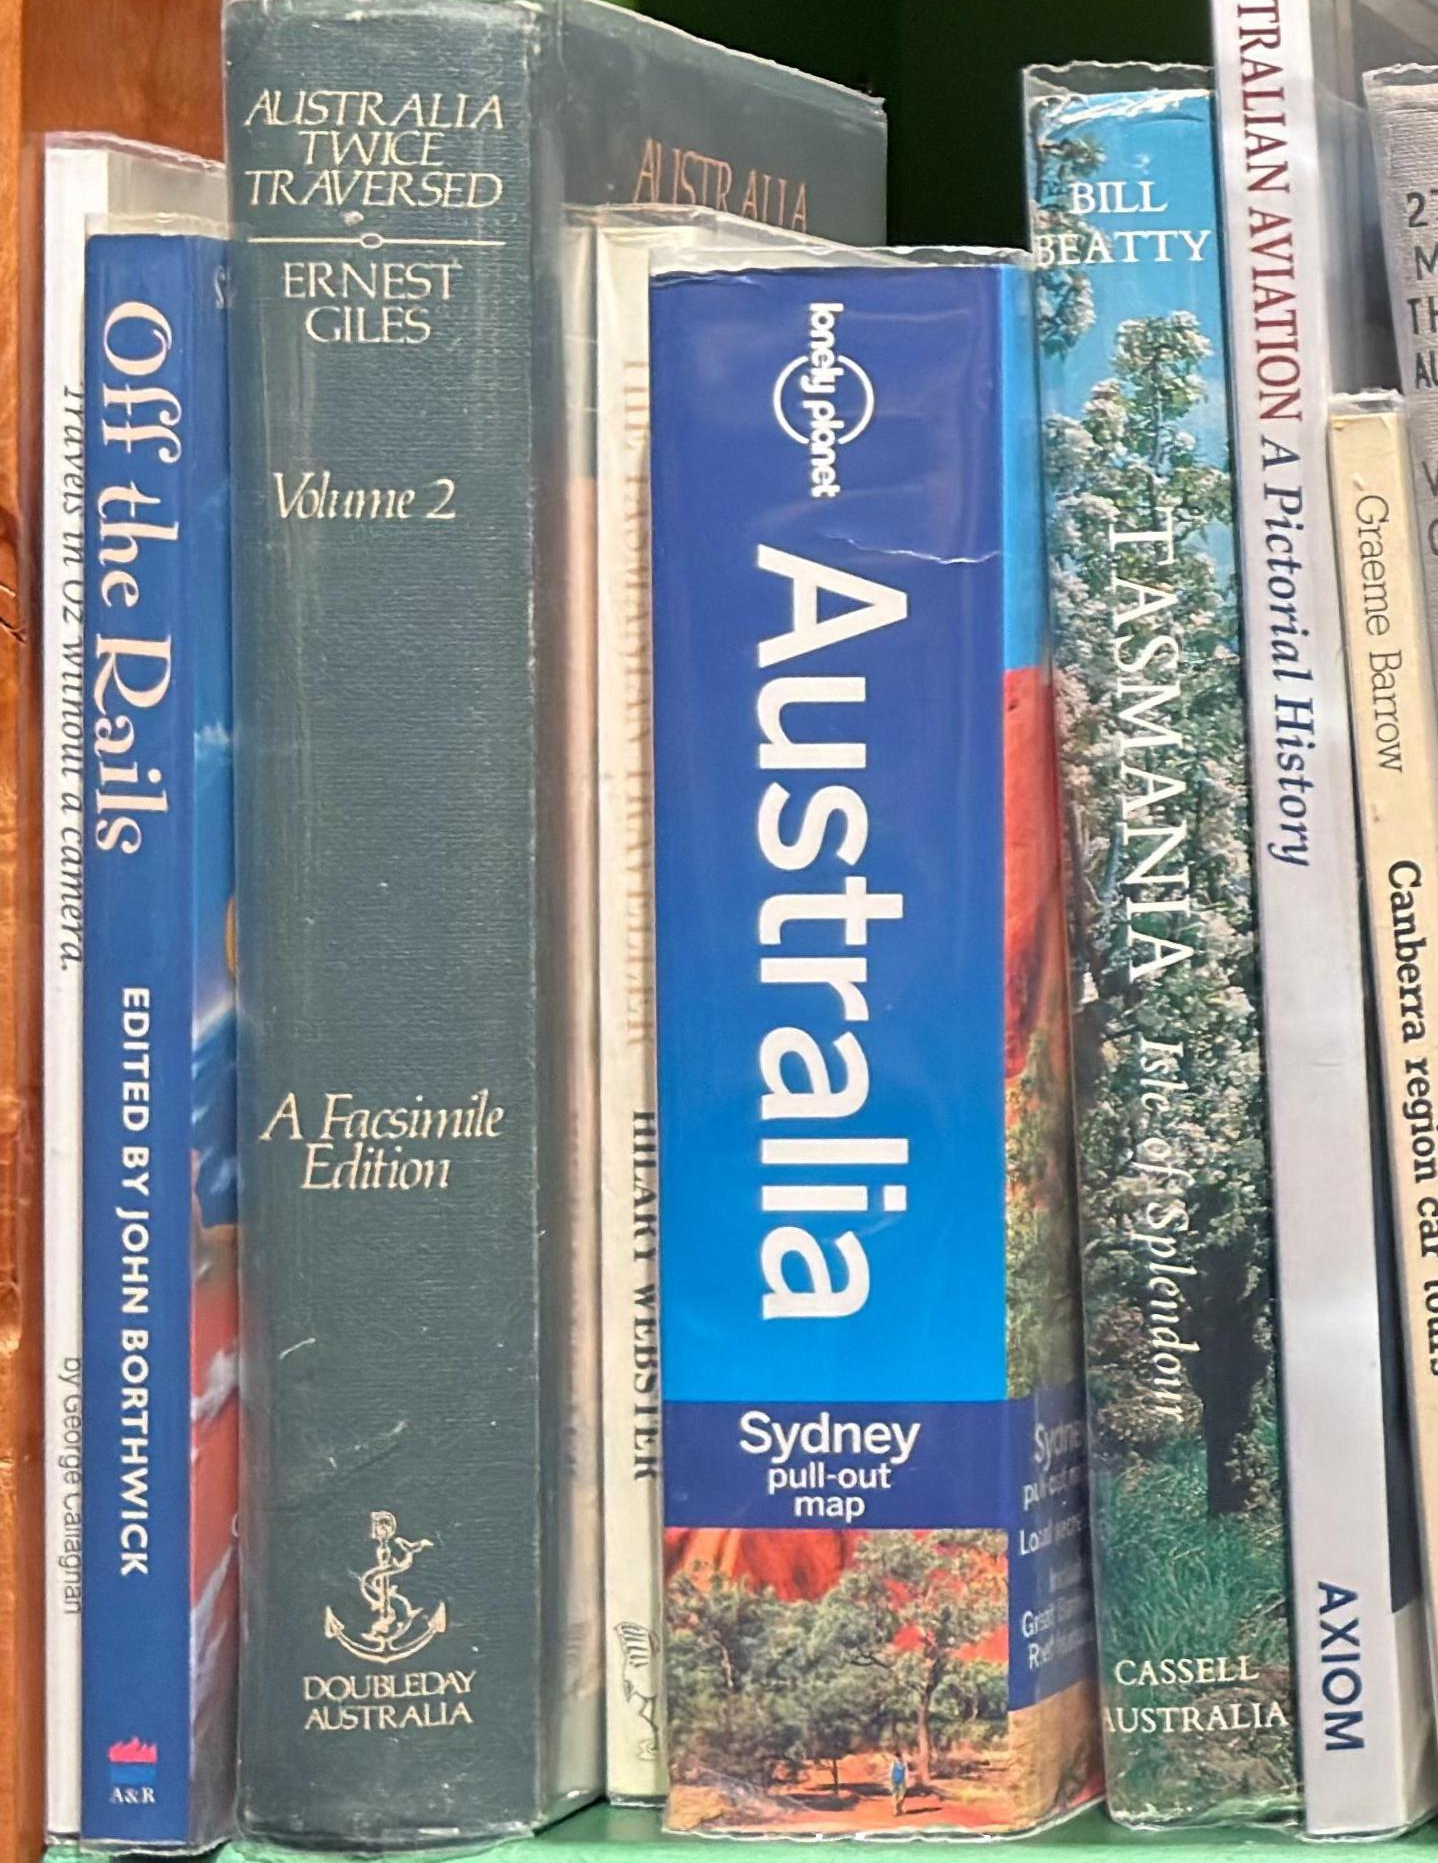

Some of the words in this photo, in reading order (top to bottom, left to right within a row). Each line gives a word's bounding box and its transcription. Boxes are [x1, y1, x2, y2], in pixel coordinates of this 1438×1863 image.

[244, 91, 505, 129] AUSTRALIA
[301, 132, 445, 166] TWICE
[244, 170, 504, 208] TRAVERSED
[1067, 180, 1168, 215] BILL
[1035, 230, 1212, 267] BEATTY
[282, 261, 462, 302] ERNEST
[305, 306, 432, 344] GILES
[1247, 206, 1304, 424] AVIATION
[803, 302, 846, 393] lonely
[102, 300, 183, 465] Off
[804, 400, 846, 498] planet
[1258, 435, 1301, 472] A
[273, 471, 416, 520] Volume
[427, 478, 458, 520] 2
[97, 480, 180, 607] the
[1354, 493, 1392, 637] Graeme
[1262, 486, 1314, 683] Pictorial
[1369, 651, 1404, 773] Barrow
[93, 634, 172, 854] Rails
[1109, 506, 1195, 983] TASMANIA
[1268, 698, 1316, 868] History
[756, 543, 909, 1320] Australia
[1386, 860, 1427, 1043] Canberra
[121, 986, 152, 1131] EDITED
[259, 1094, 308, 1141] A
[320, 1087, 506, 1141] Facsimile
[121, 1146, 151, 1192] BY
[303, 1142, 450, 1192] Edition
[1133, 1137, 1194, 1195] of
[116, 1198, 151, 1314] JOHN
[1146, 1197, 1202, 1424] Splendour
[120, 1328, 150, 1577] BORTHWICK
[739, 1411, 921, 1464] Sydney
[767, 1463, 892, 1495] pull-out
[794, 1492, 865, 1522] map
[303, 1670, 475, 1700] DOUBLEDAY
[1114, 1655, 1260, 1686] CASSELL
[1318, 1580, 1365, 1752] AXIOM
[305, 1699, 473, 1732] AUSTRALIA
[110, 1786, 157, 1805] A&R
